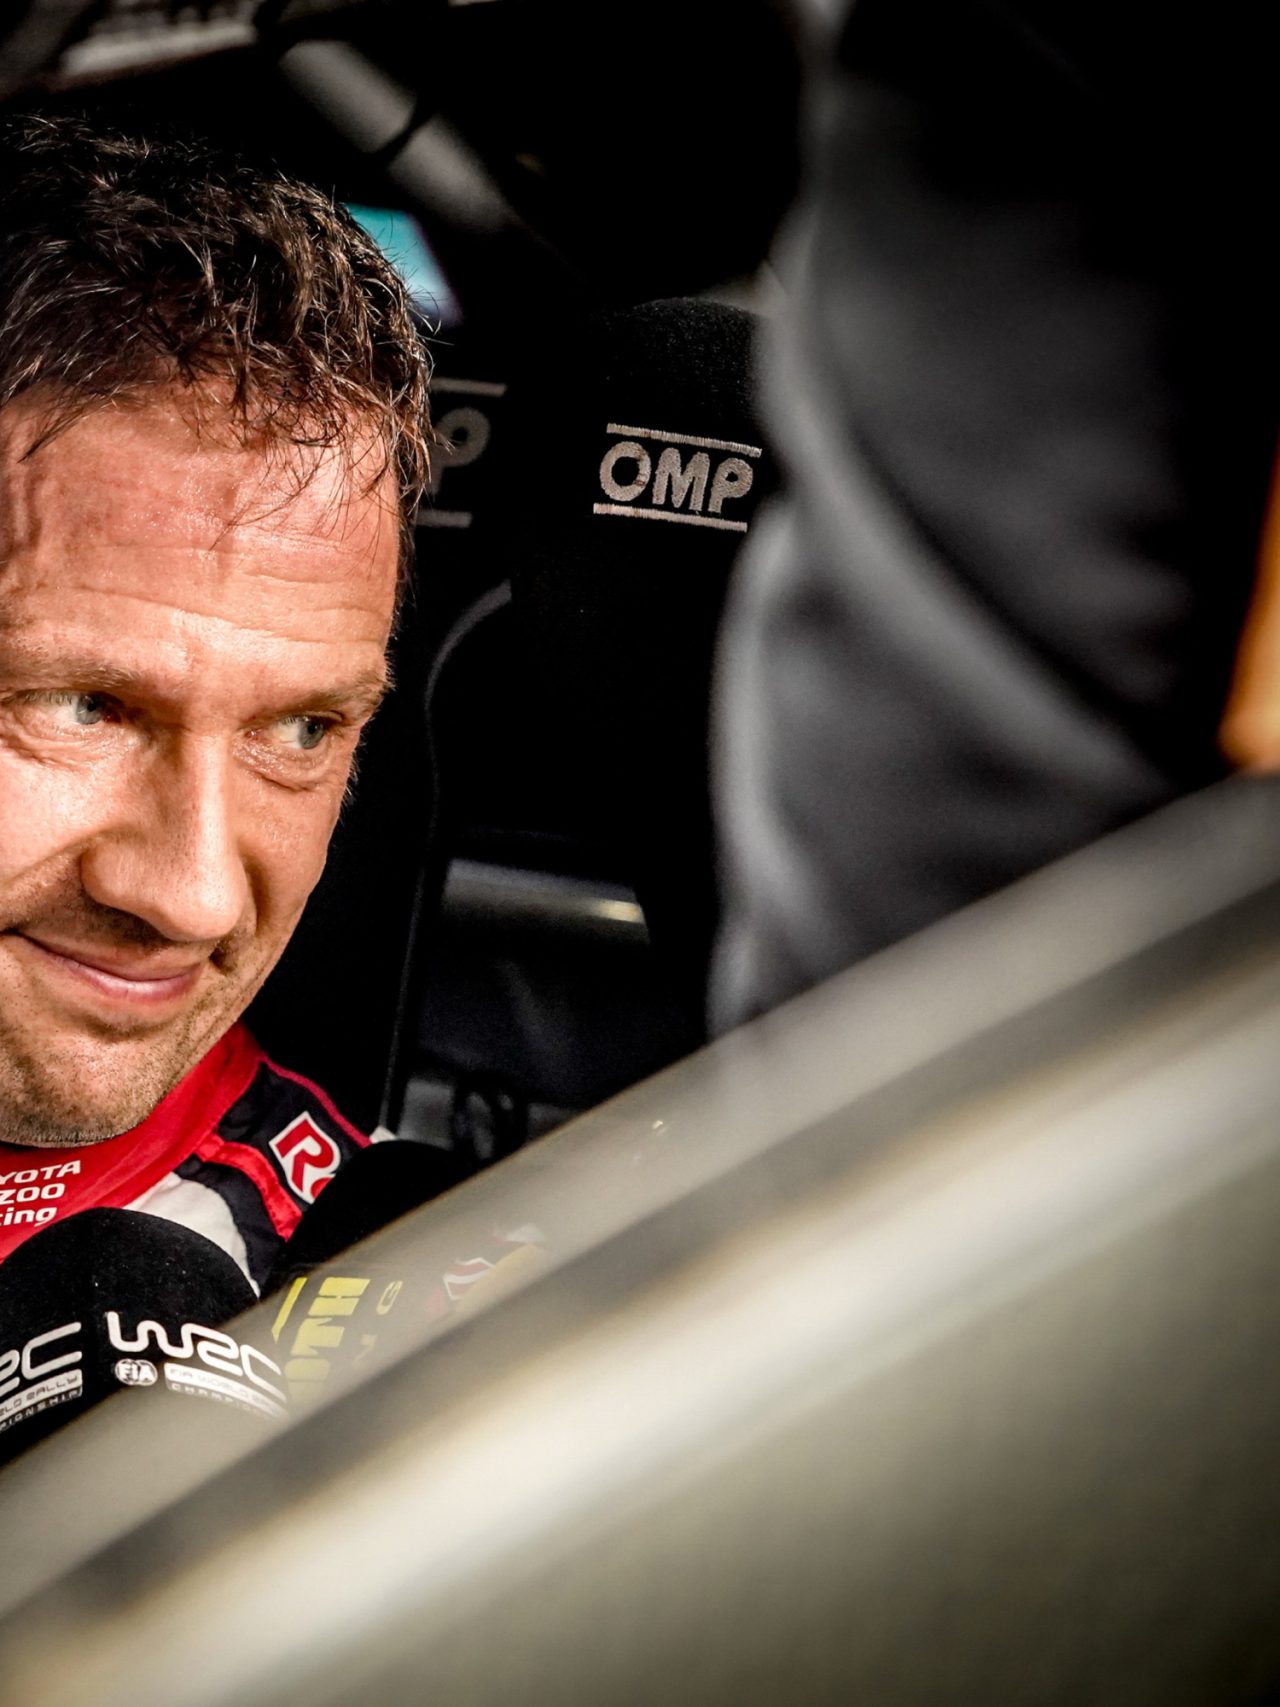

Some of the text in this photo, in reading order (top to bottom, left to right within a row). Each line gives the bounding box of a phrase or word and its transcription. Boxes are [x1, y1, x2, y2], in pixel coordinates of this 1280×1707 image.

[599, 441, 754, 514] OMP
[107, 1311, 287, 1404] WRC
[117, 1360, 157, 1385] FIA
[26, 1374, 79, 1402] RALLY
